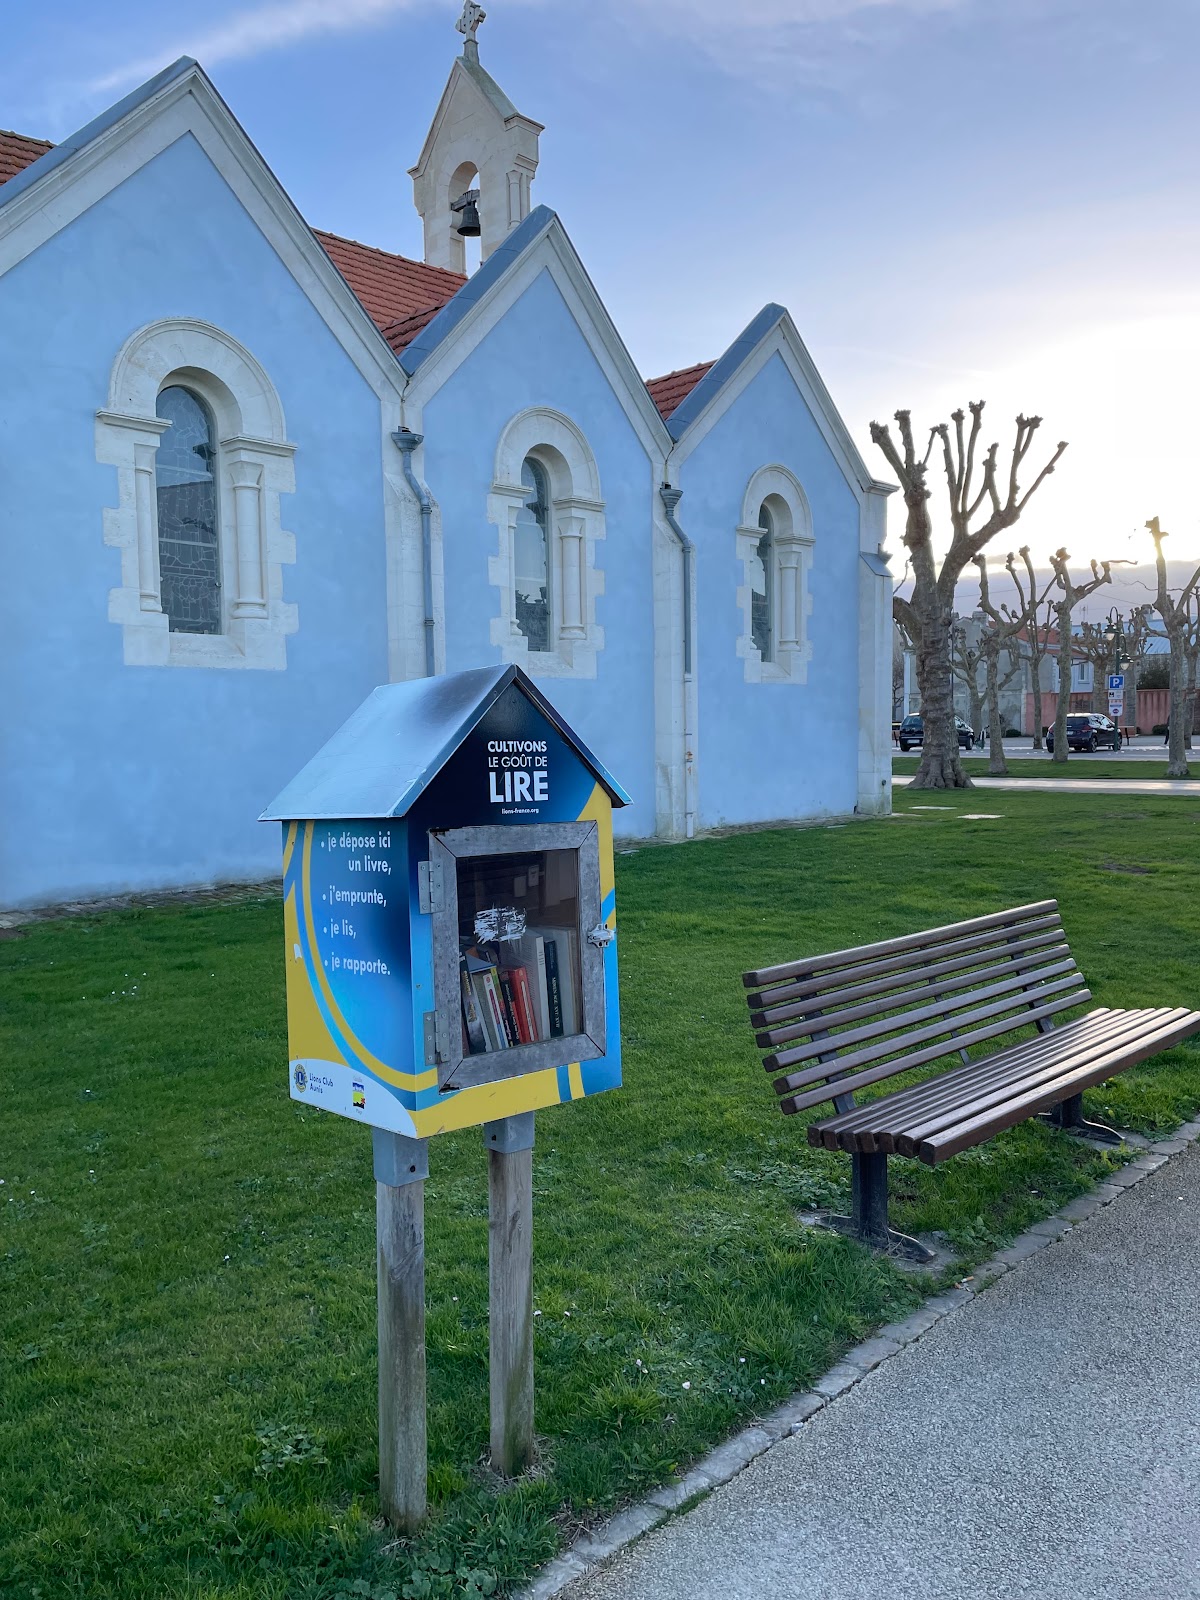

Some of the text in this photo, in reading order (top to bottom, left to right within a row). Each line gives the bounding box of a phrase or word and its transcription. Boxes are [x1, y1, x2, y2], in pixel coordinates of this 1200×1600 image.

[1113, 678, 1120, 687] P
[487, 740, 548, 753] CULTIVONS
[488, 753, 548, 768] LE GOÛT DE
[489, 770, 549, 803] LIRE
[501, 807, 540, 815] lions-france.org
[327, 830, 391, 852] je dépose ici
[348, 855, 392, 875] un livre,
[329, 885, 387, 908] j'emprunte,
[330, 918, 357, 939] je lis,
[331, 952, 391, 976] je rapporte.
[309, 1073, 334, 1087] Lions Club
[309, 1082, 323, 1094] Aunis
